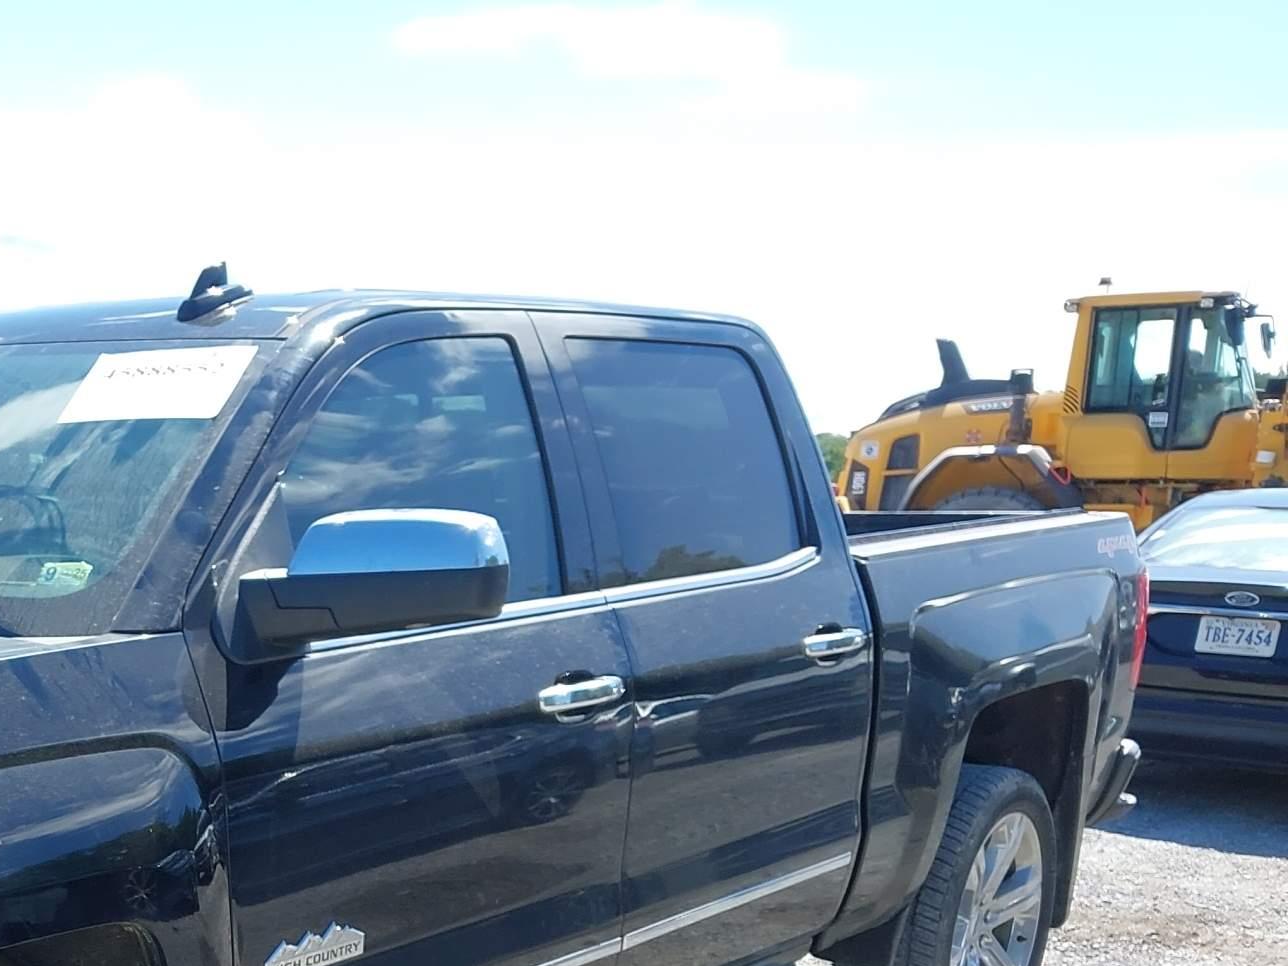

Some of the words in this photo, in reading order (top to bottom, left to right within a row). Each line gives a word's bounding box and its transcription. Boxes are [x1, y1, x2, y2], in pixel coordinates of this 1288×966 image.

[45, 566, 57, 582] 9
[1205, 626, 1273, 647] TBE-7454
[305, 940, 361, 966] COUNTRY
